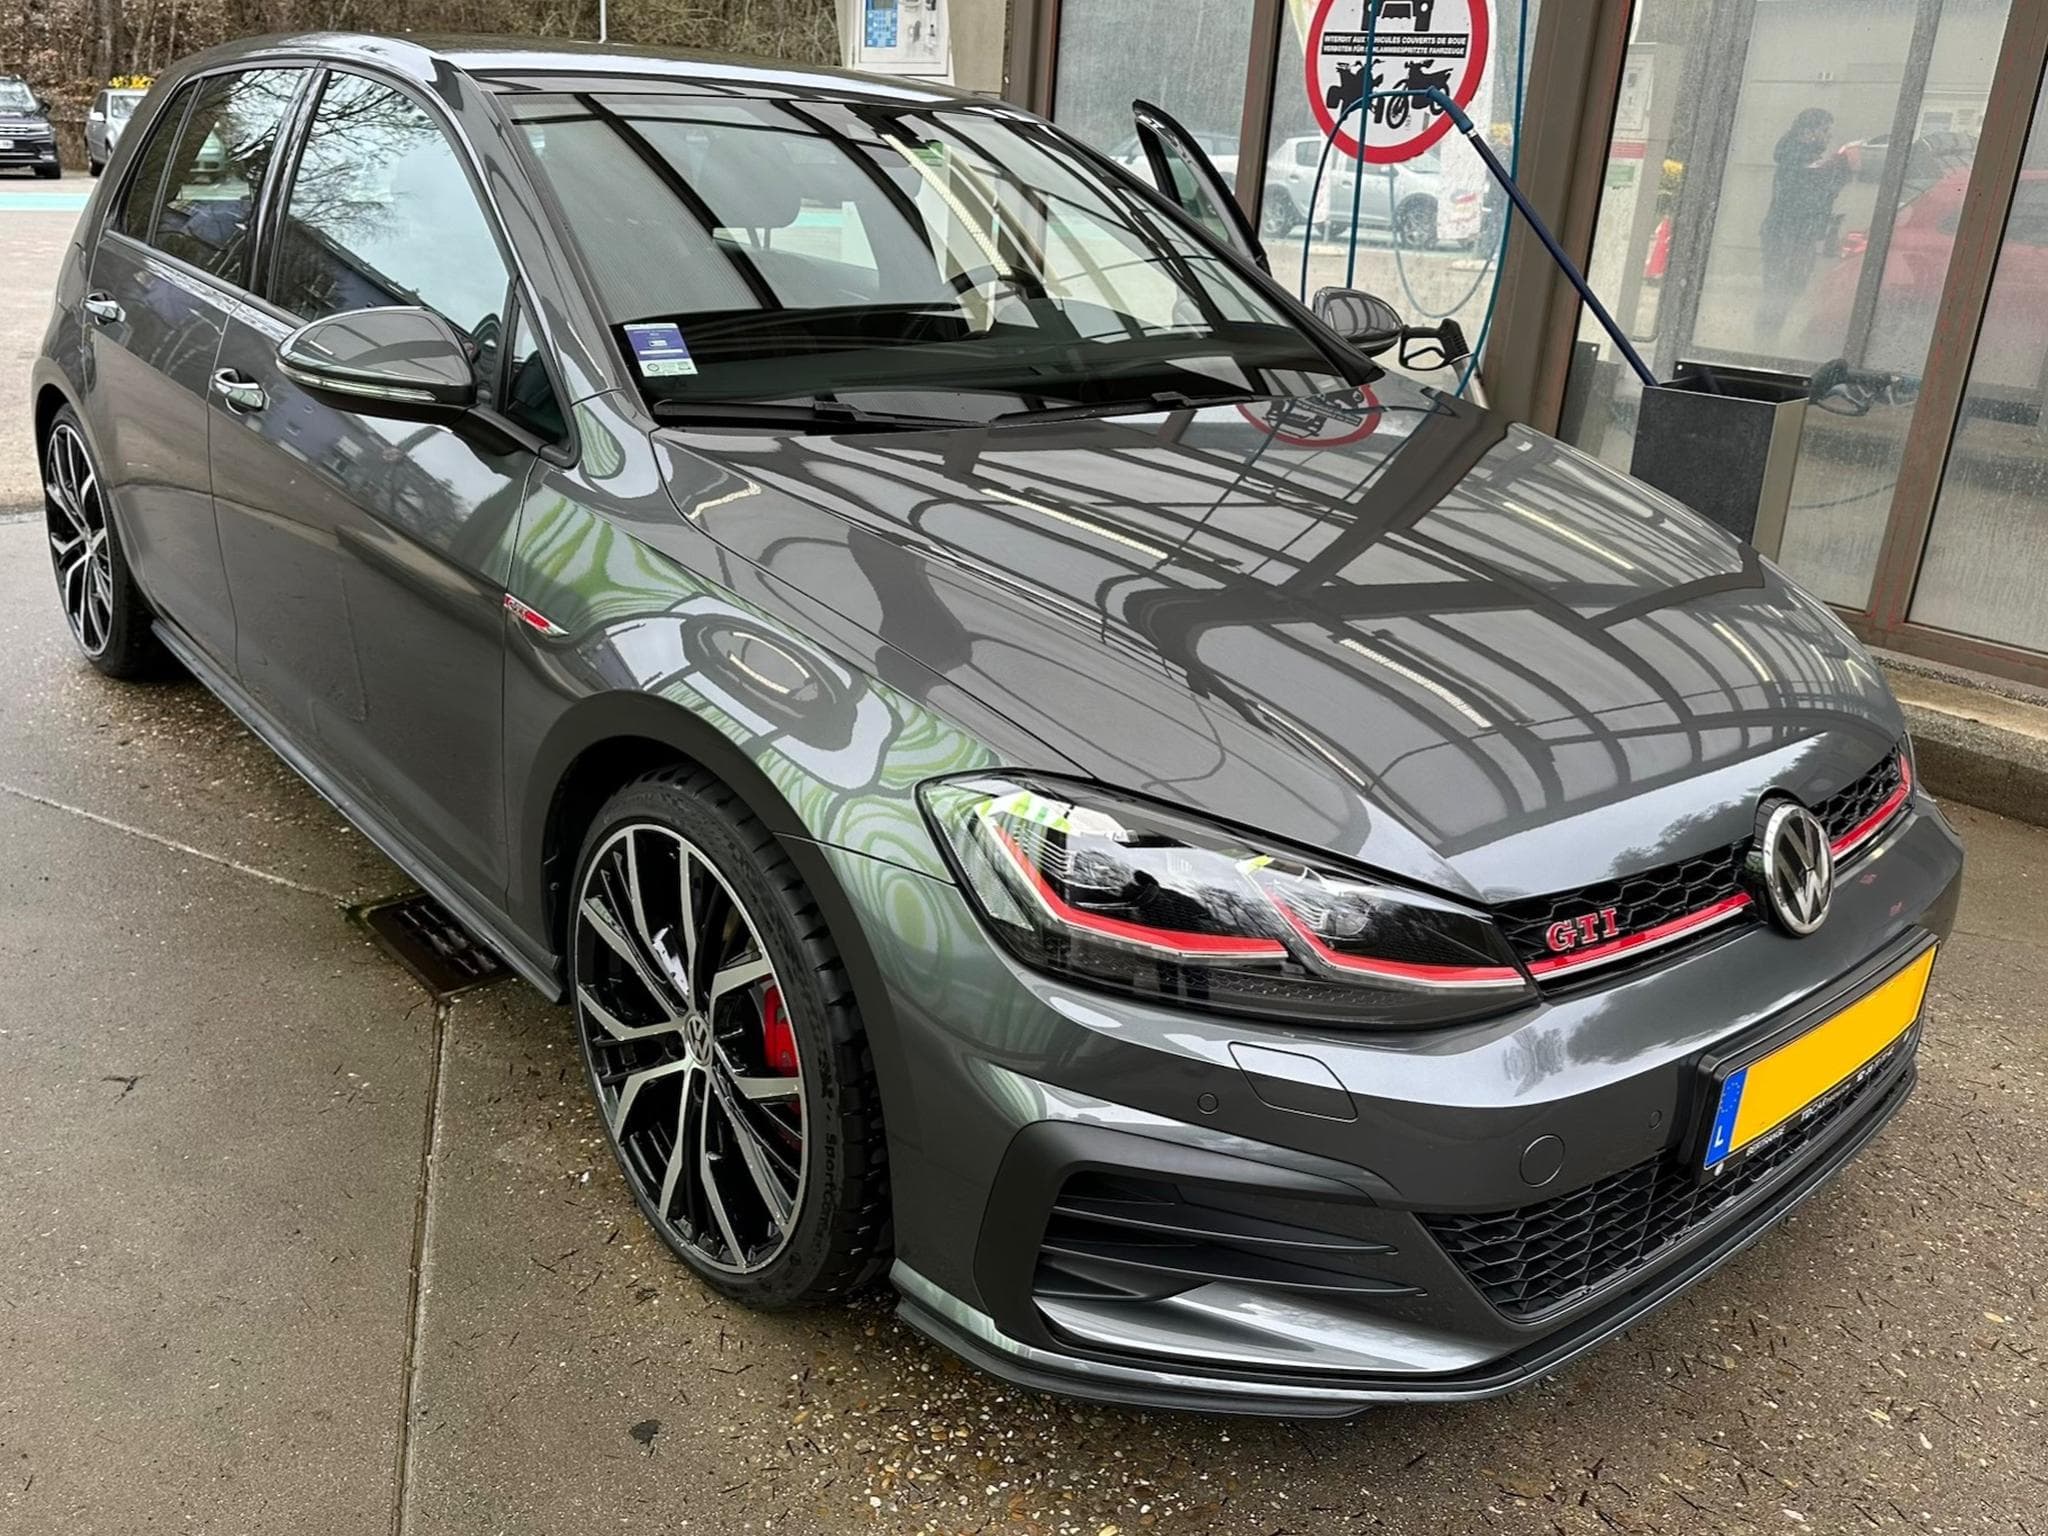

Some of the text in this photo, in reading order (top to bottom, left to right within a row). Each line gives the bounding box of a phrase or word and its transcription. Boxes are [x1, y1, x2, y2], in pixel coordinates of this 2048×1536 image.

[1324, 35, 1352, 43] INTERDIT
[1365, 36, 1400, 44] HICULES
[1401, 36, 1435, 45] COUVERTS
[1436, 37, 1446, 45] DE
[1447, 37, 1466, 45] BOUE
[1323, 45, 1352, 53] VERBOTEN
[1365, 45, 1428, 54] HLAMMBESPRITZTE
[1428, 46, 1465, 55] FAHRZEUGE
[1546, 908, 1619, 952] GTI
[1714, 1125, 1724, 1148] L
